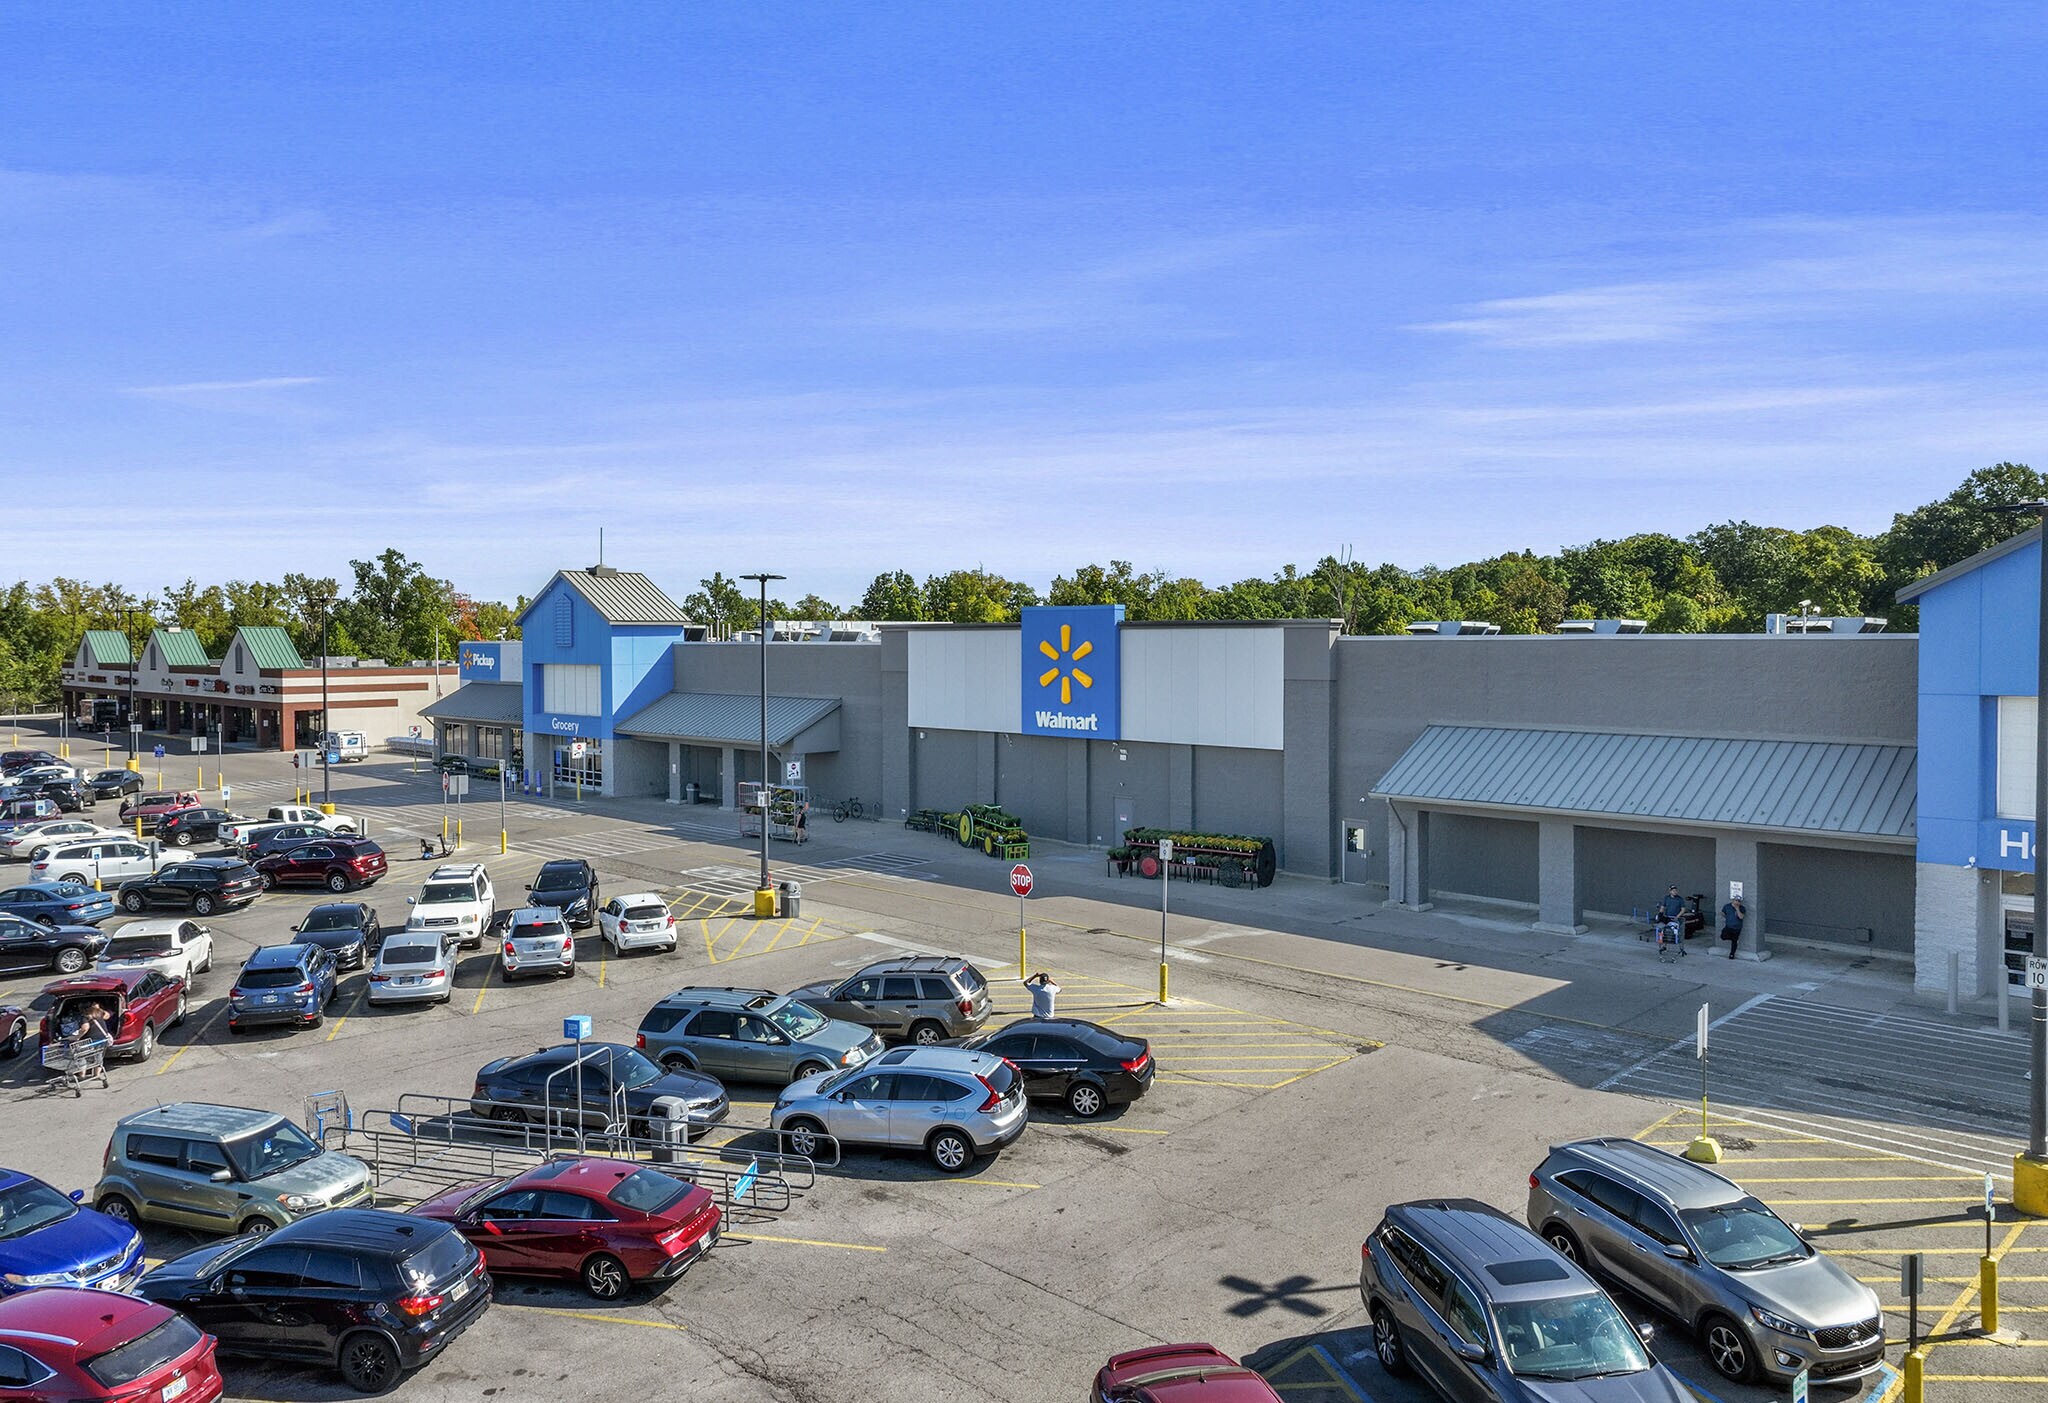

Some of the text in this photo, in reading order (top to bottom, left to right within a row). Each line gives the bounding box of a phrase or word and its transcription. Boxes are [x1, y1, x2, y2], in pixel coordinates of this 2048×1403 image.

[473, 653, 495, 670] Pickup
[551, 717, 580, 735] Grocery
[1035, 711, 1098, 731] Walmart
[2000, 829, 2036, 860] H
[1012, 873, 1031, 887] STOP
[2029, 960, 2047, 970] ROW
[2032, 972, 2045, 985] 10
